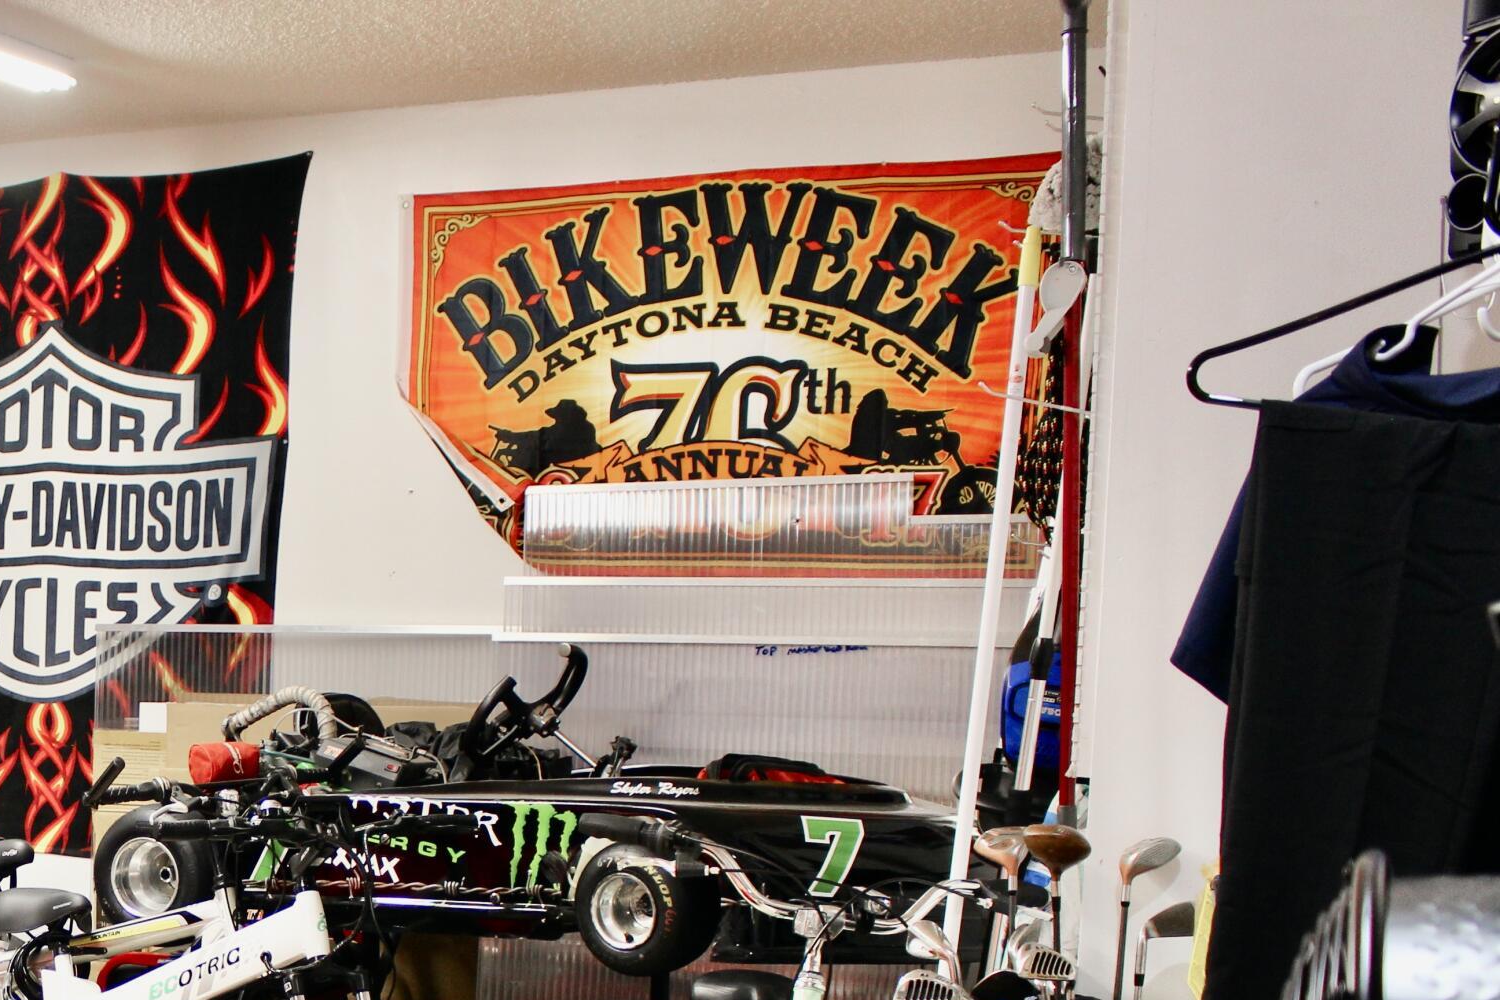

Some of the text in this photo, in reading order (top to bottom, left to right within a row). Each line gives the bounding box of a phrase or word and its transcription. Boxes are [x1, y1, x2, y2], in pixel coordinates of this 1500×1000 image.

[507, 301, 940, 403] DAYTONA BEACH
[800, 815, 865, 898] 7
[148, 947, 241, 1000] ECOTRIC
